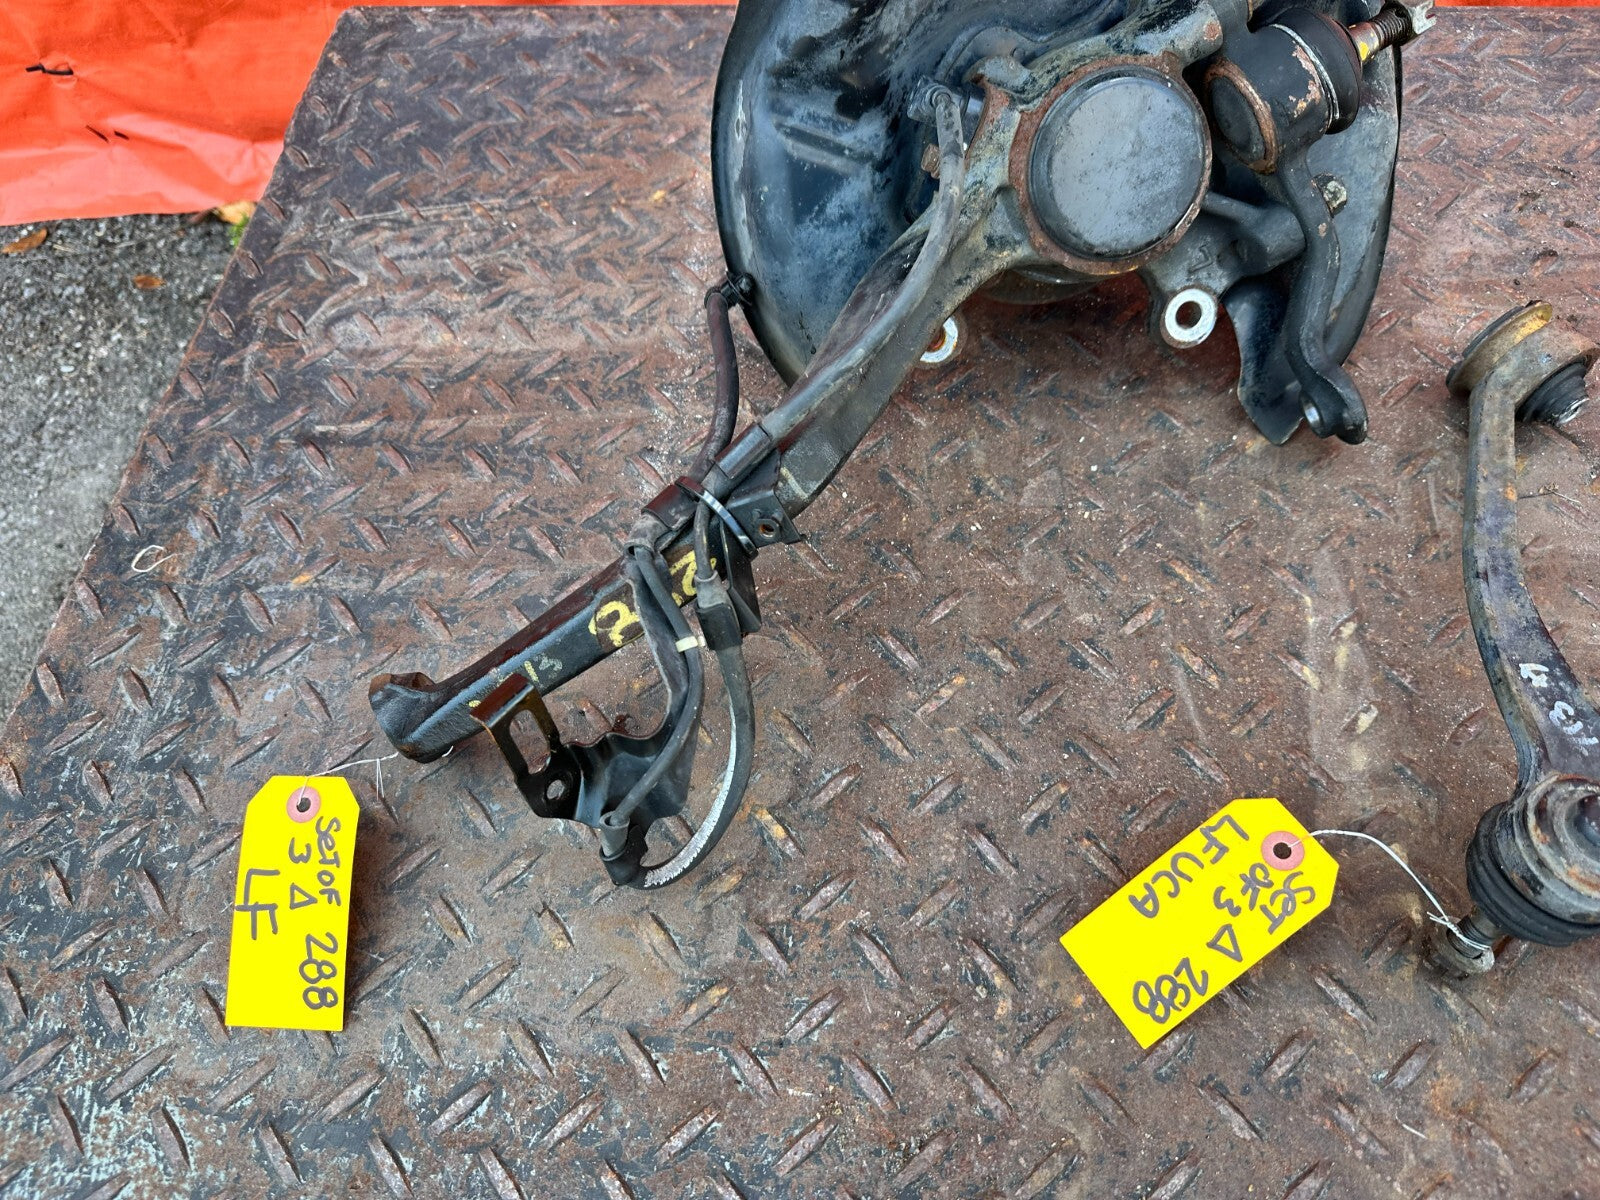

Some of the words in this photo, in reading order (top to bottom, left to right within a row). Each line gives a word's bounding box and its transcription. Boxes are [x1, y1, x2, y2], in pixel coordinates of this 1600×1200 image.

[288, 837, 312, 864] 3
[235, 868, 281, 940] LF
[1213, 885, 1242, 917] 3
[299, 932, 338, 1010] 288
[1132, 957, 1209, 1024] 288
